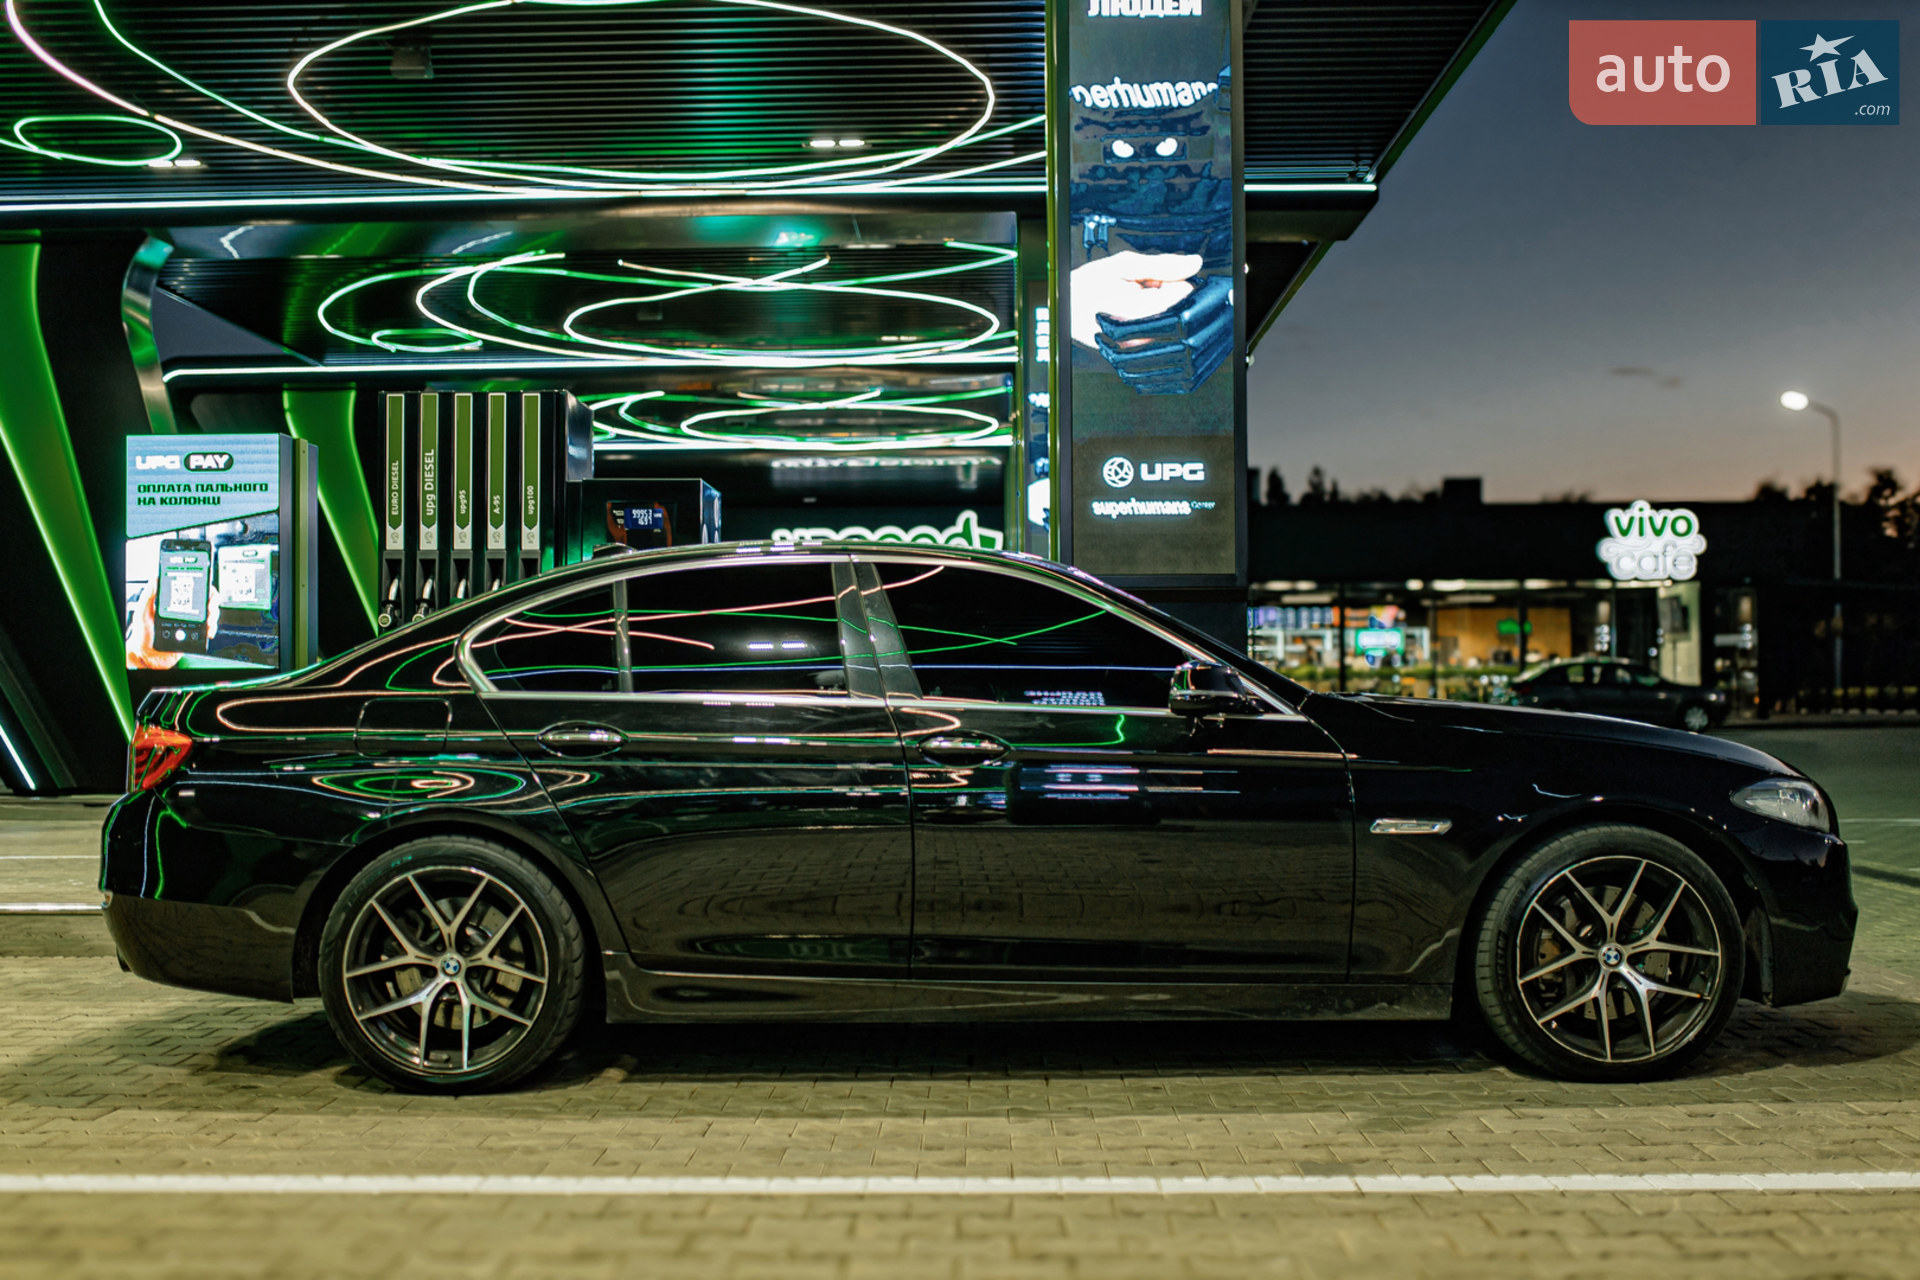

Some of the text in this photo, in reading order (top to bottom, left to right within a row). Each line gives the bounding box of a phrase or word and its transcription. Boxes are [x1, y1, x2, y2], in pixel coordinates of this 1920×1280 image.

[135, 454, 230, 470] UPG PAY
[1140, 462, 1205, 481] UPG
[137, 482, 269, 493] ОПЛАТА ПАЛЬНОГО
[391, 460, 399, 516] EURO DIESEL
[424, 448, 436, 516] upg DIESEL
[137, 496, 221, 506] НА КОЛОНЦІ
[458, 489, 468, 515] upg95
[526, 485, 536, 516] upg100
[1092, 497, 1192, 519] superhumans
[1614, 506, 1694, 538] vivo
[1614, 539, 1695, 578] cafe
